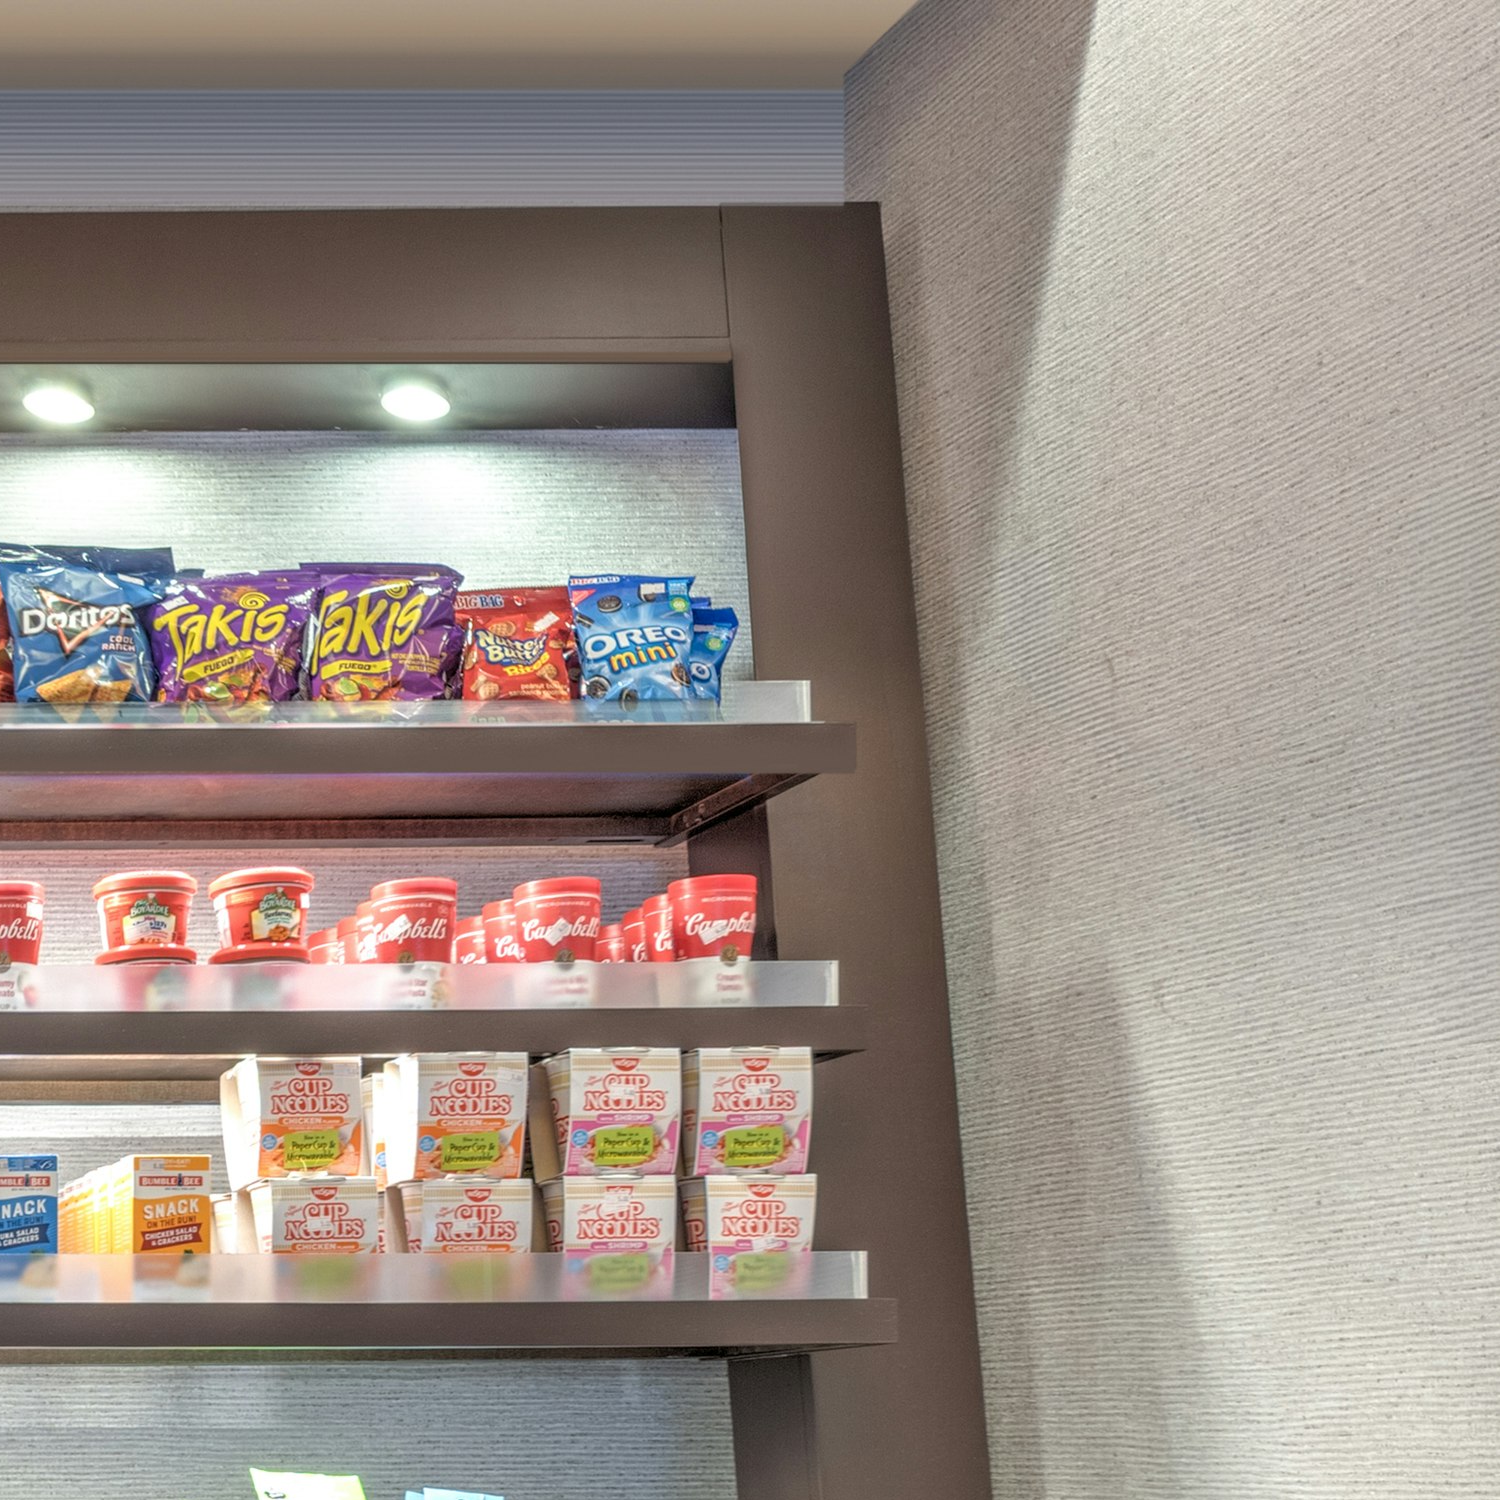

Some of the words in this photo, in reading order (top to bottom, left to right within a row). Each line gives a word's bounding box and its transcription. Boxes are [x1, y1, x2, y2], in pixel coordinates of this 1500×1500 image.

[455, 595, 478, 607] BIG
[479, 595, 503, 608] BAG
[21, 604, 136, 637] Doritos
[312, 588, 426, 674] Takis
[153, 601, 288, 680] Takis
[584, 626, 686, 659] OREO
[202, 656, 235, 673] FUEGO
[609, 642, 677, 672] mini
[338, 663, 372, 671] FUEGO
[288, 1078, 332, 1096] CUP
[449, 1079, 496, 1097] CUP
[603, 1074, 650, 1091] CUP
[733, 1074, 780, 1092] CUP
[271, 1094, 349, 1114] NOODLES
[430, 1095, 512, 1116] NOODLES
[584, 1090, 666, 1111] NOODLES
[713, 1090, 796, 1112] NOODLES
[31, 1177, 48, 1186] BEE
[142, 1177, 177, 1187] BUMBLE
[184, 1177, 201, 1186] BEE
[143, 1198, 199, 1220] SNACK
[304, 1203, 349, 1220] CUP
[455, 1205, 501, 1223] CUP
[739, 1199, 785, 1218] CUP
[6, 1219, 21, 1228] THE
[24, 1216, 44, 1226] RUN!
[160, 1218, 175, 1227] THE
[177, 1215, 197, 1225] RUN!
[577, 1217, 660, 1239] NOODLES
[721, 1216, 800, 1237] NOODLES
[16, 1227, 39, 1238] SALAD
[145, 1229, 175, 1241] CHICKEN
[175, 1226, 198, 1237] SALAD
